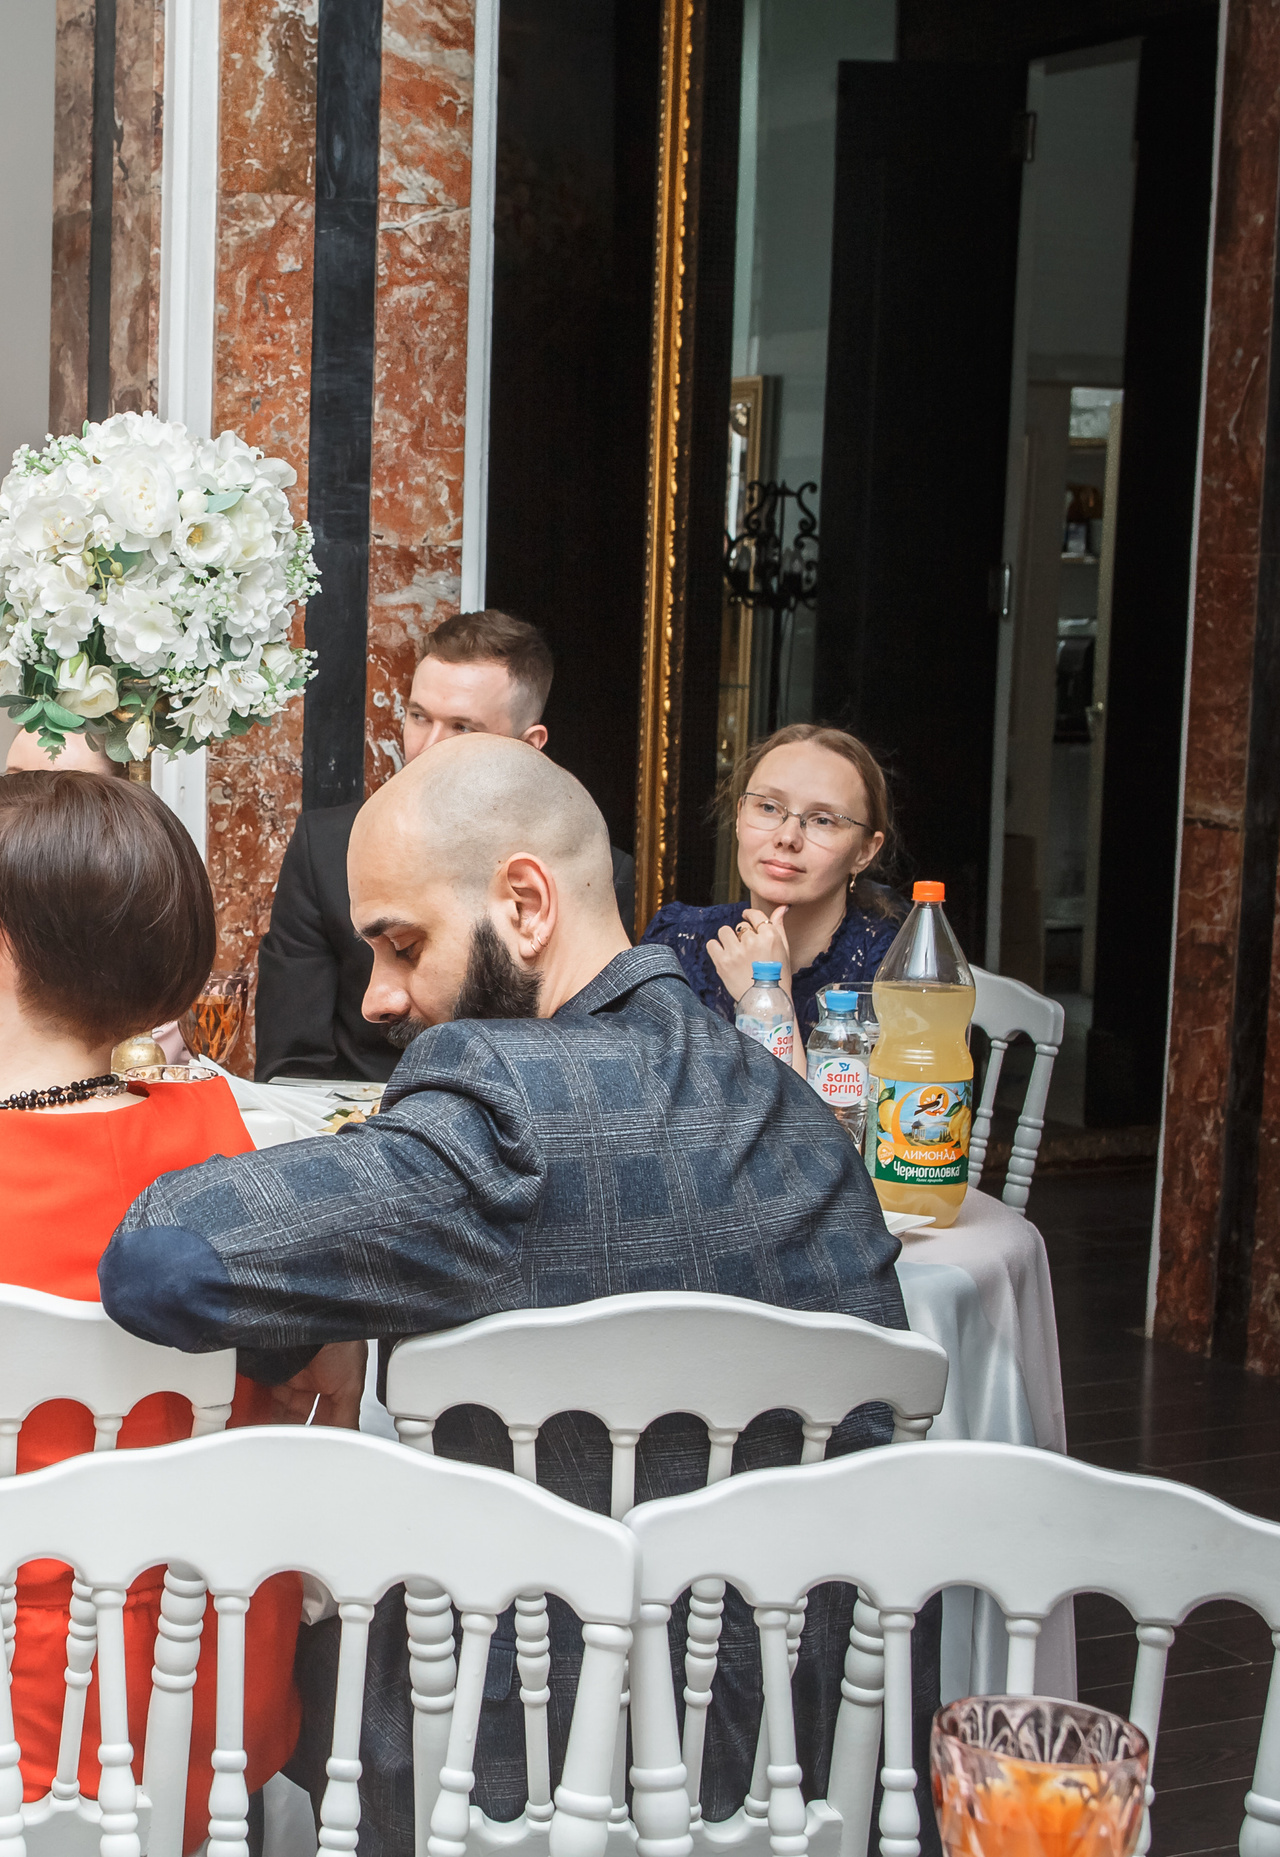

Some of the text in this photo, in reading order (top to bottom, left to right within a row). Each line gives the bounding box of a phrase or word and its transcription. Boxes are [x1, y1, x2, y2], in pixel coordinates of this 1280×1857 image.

[827, 1072, 860, 1082] saint
[822, 1083, 863, 1096] spring
[903, 1149, 956, 1161] ЛИМОНАД
[894, 1160, 960, 1180] Черноголовка
